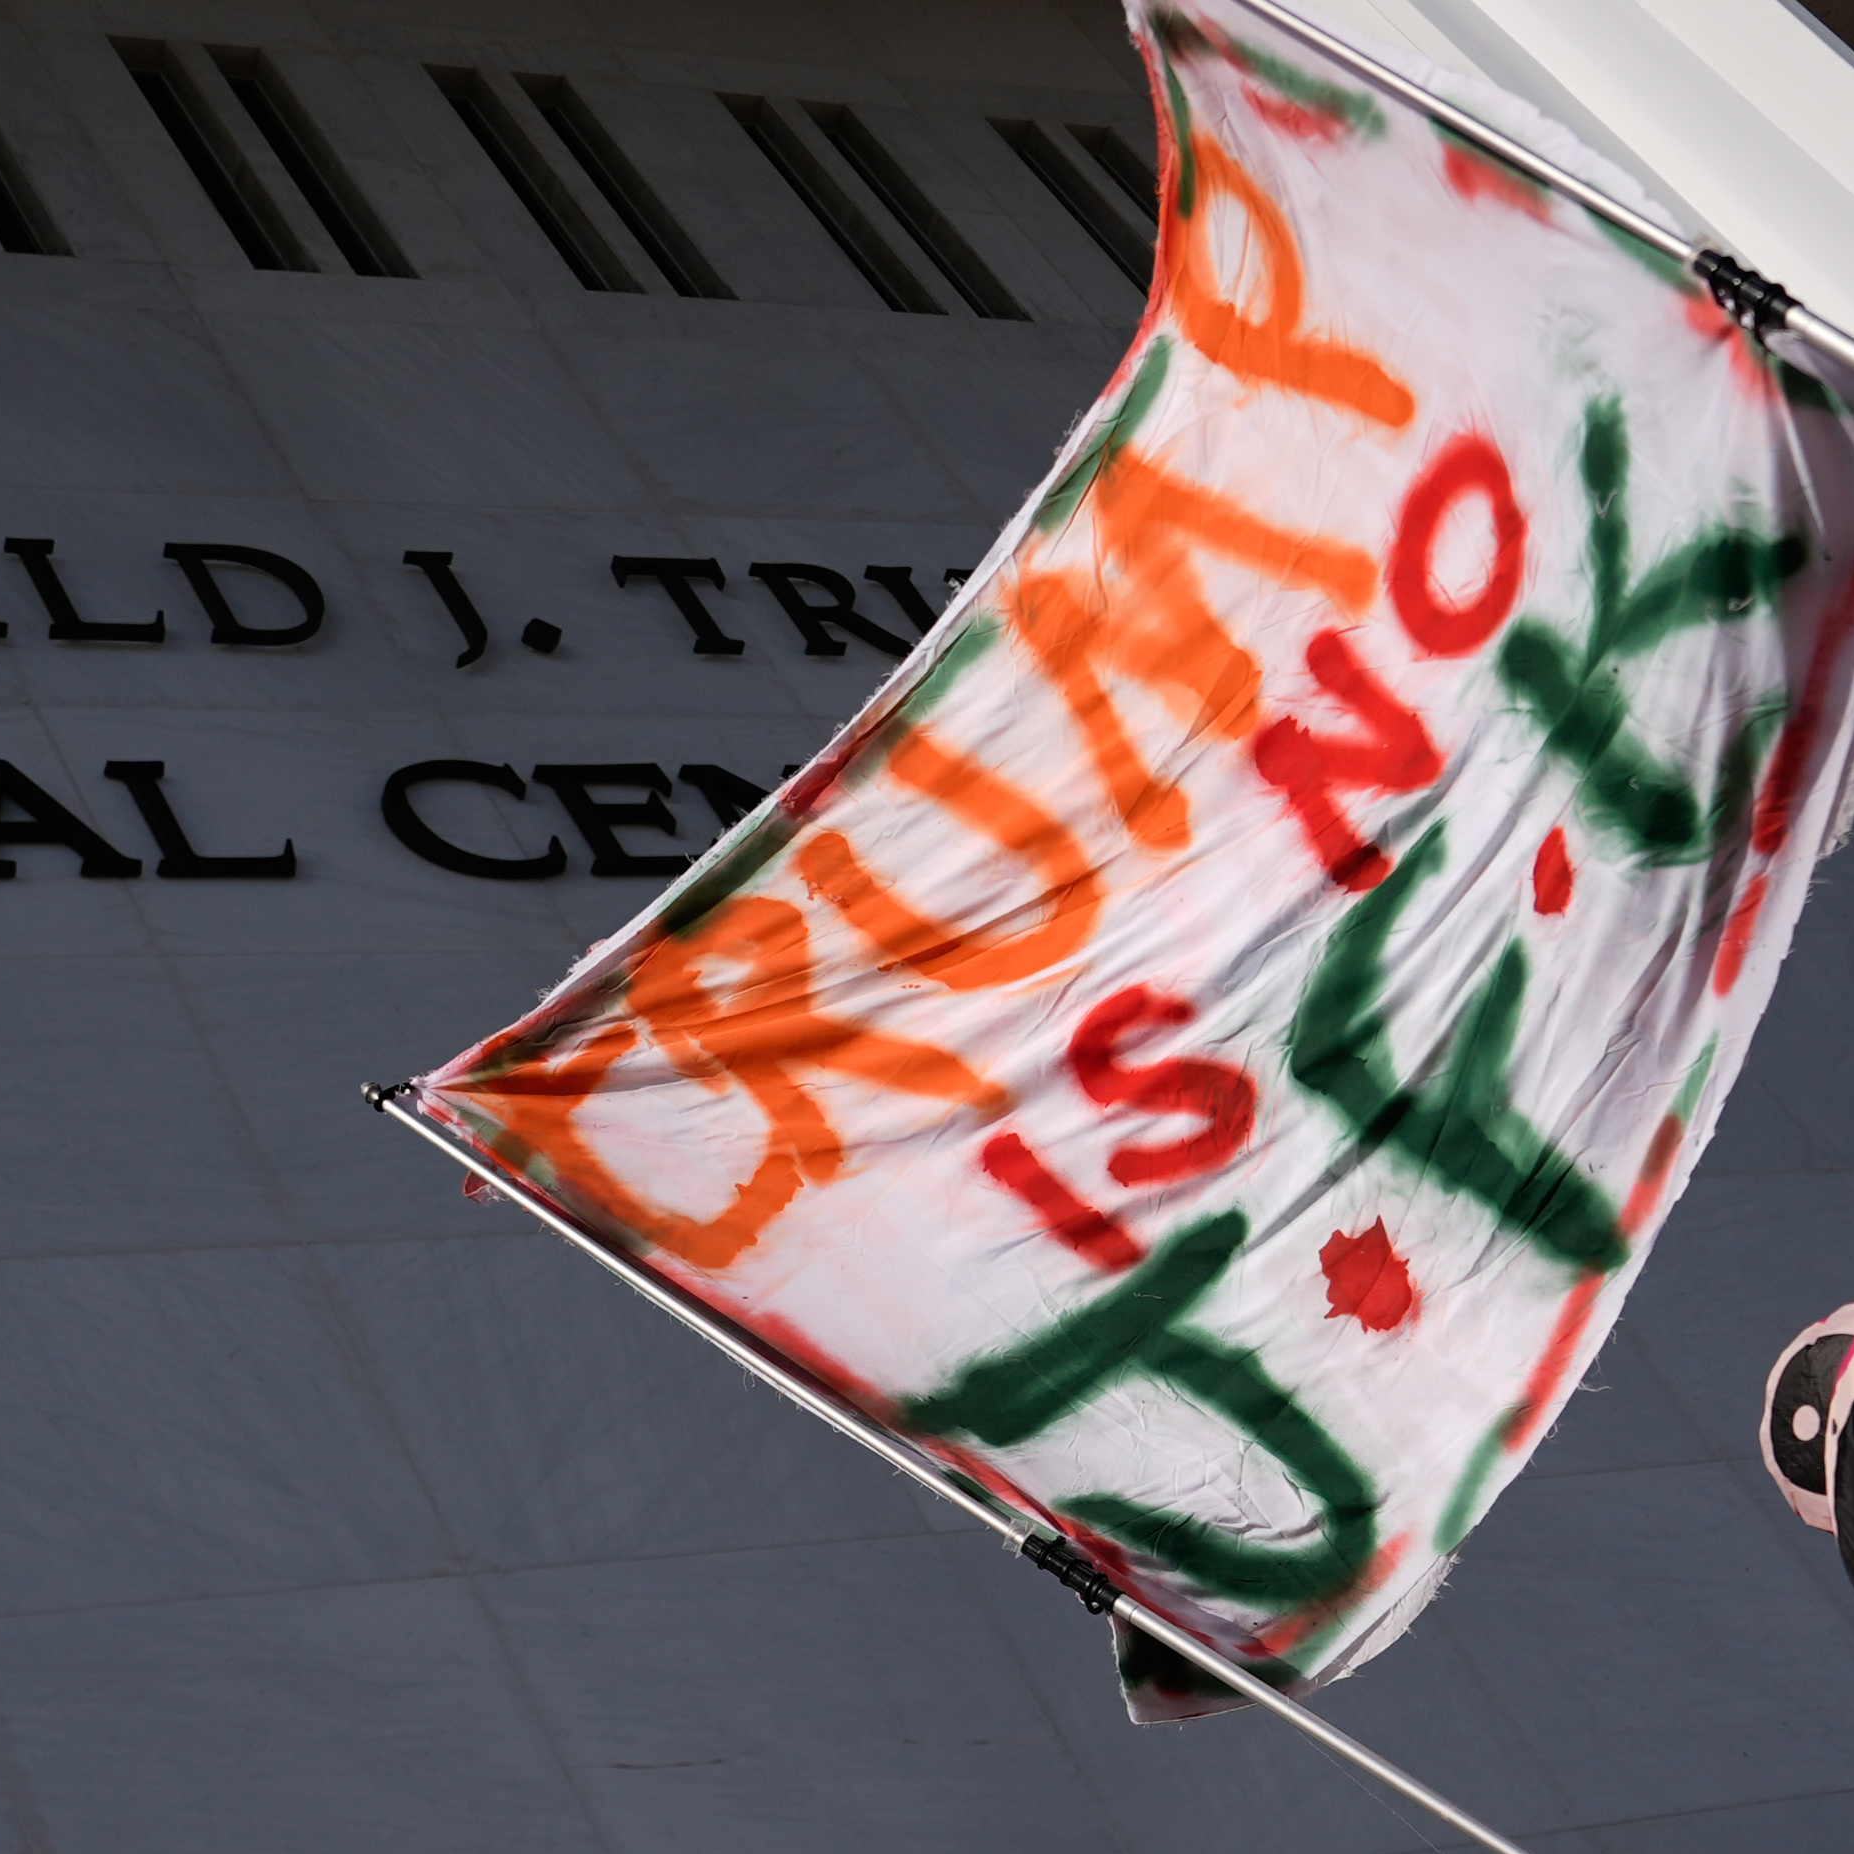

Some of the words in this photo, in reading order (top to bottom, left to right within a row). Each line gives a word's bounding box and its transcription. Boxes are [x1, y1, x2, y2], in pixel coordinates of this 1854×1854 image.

[403, 550, 563, 669] J.
[381, 758, 802, 881] CE
[982, 987, 1256, 1272] IS
[1254, 430, 1526, 893] NO
